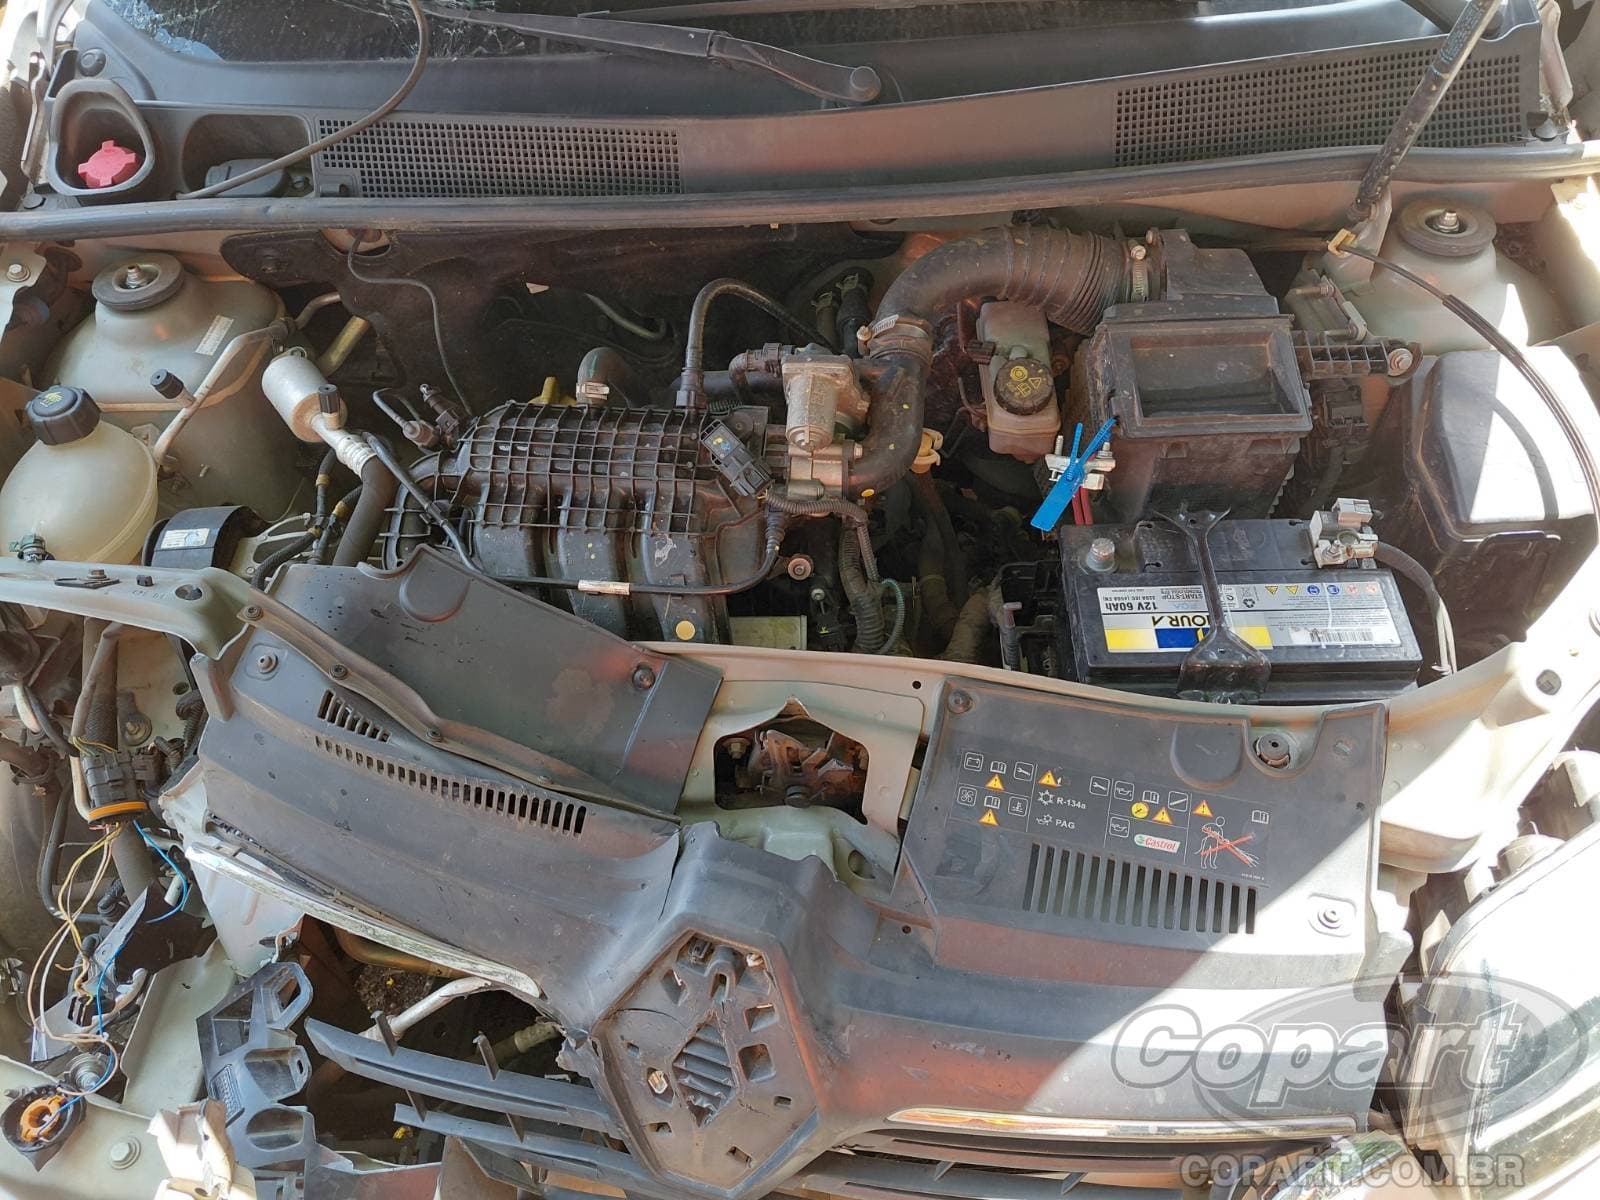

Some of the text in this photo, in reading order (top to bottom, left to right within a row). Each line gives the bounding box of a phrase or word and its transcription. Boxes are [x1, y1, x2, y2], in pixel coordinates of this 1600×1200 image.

[1105, 602, 1134, 611] 60Ah
[1137, 601, 1158, 611] 12V
[1152, 615, 1210, 627] OURA
[1056, 797, 1086, 810] R-134a
[1055, 819, 1076, 830] PAG
[1145, 837, 1177, 851] Castrol
